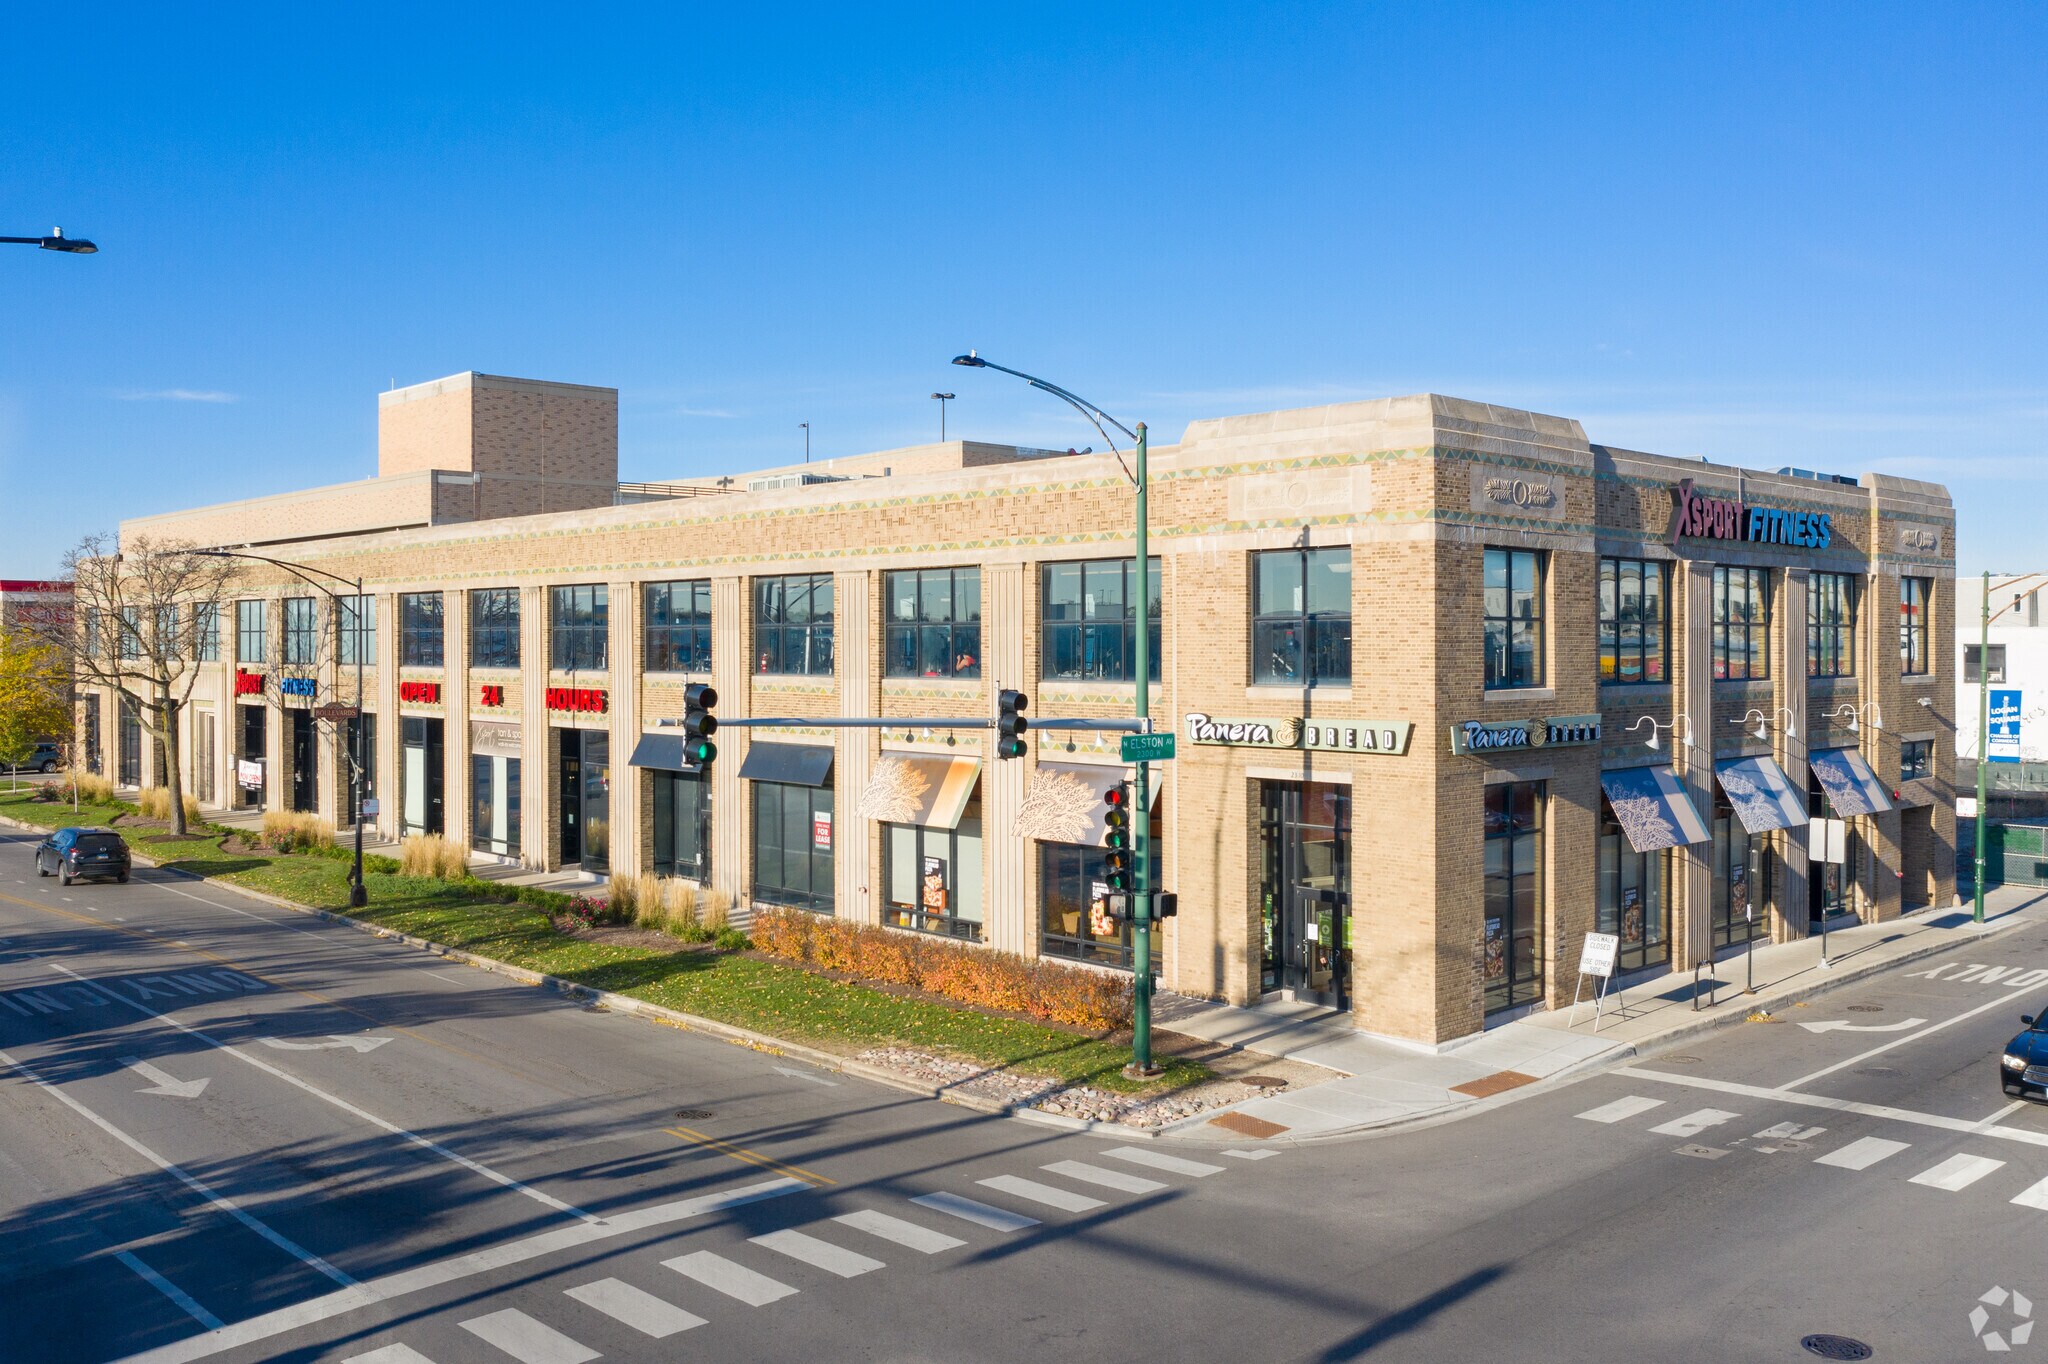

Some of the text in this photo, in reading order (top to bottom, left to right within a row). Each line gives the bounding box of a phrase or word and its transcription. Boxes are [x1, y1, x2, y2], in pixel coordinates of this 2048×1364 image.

[1673, 478, 1830, 548] XSPORT FITNESS
[281, 677, 315, 697] FITNESS
[401, 682, 436, 704] OPEN
[481, 685, 499, 705] 24
[546, 687, 604, 712] HOURS
[1990, 716, 2020, 725] SQUARE
[1991, 707, 2018, 715] LOGAN
[1185, 713, 1393, 748] Panera BREAD
[1464, 720, 1600, 750] Panera BREAD
[1131, 737, 1164, 749] ELSTON
[815, 835, 830, 843] LEASE
[1590, 942, 1611, 950] CLOSED
[1903, 962, 2048, 986] ONLY
[121, 971, 268, 1000] ONLY
